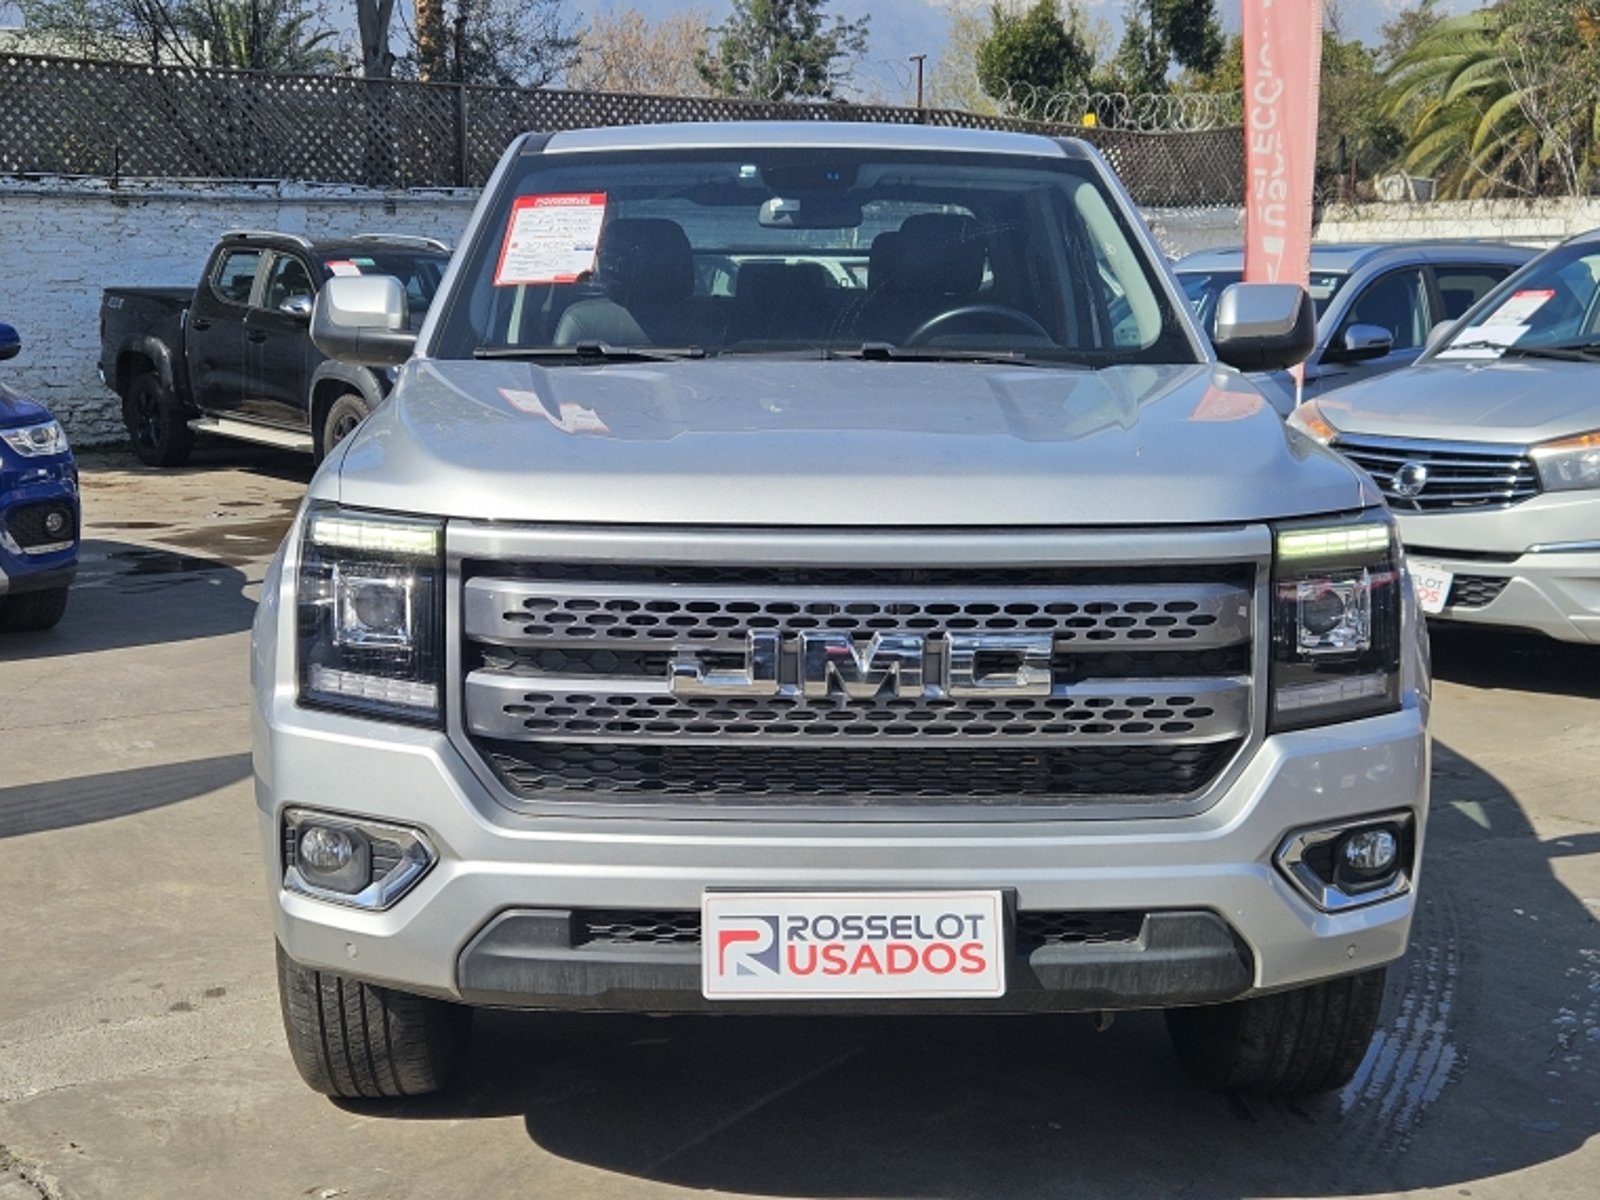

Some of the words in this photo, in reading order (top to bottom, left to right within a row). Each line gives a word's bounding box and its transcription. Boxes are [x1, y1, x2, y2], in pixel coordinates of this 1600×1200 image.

[668, 628, 1054, 698] JMC
[787, 913, 985, 941] ROSSELOT
[787, 942, 987, 976] USADOS
